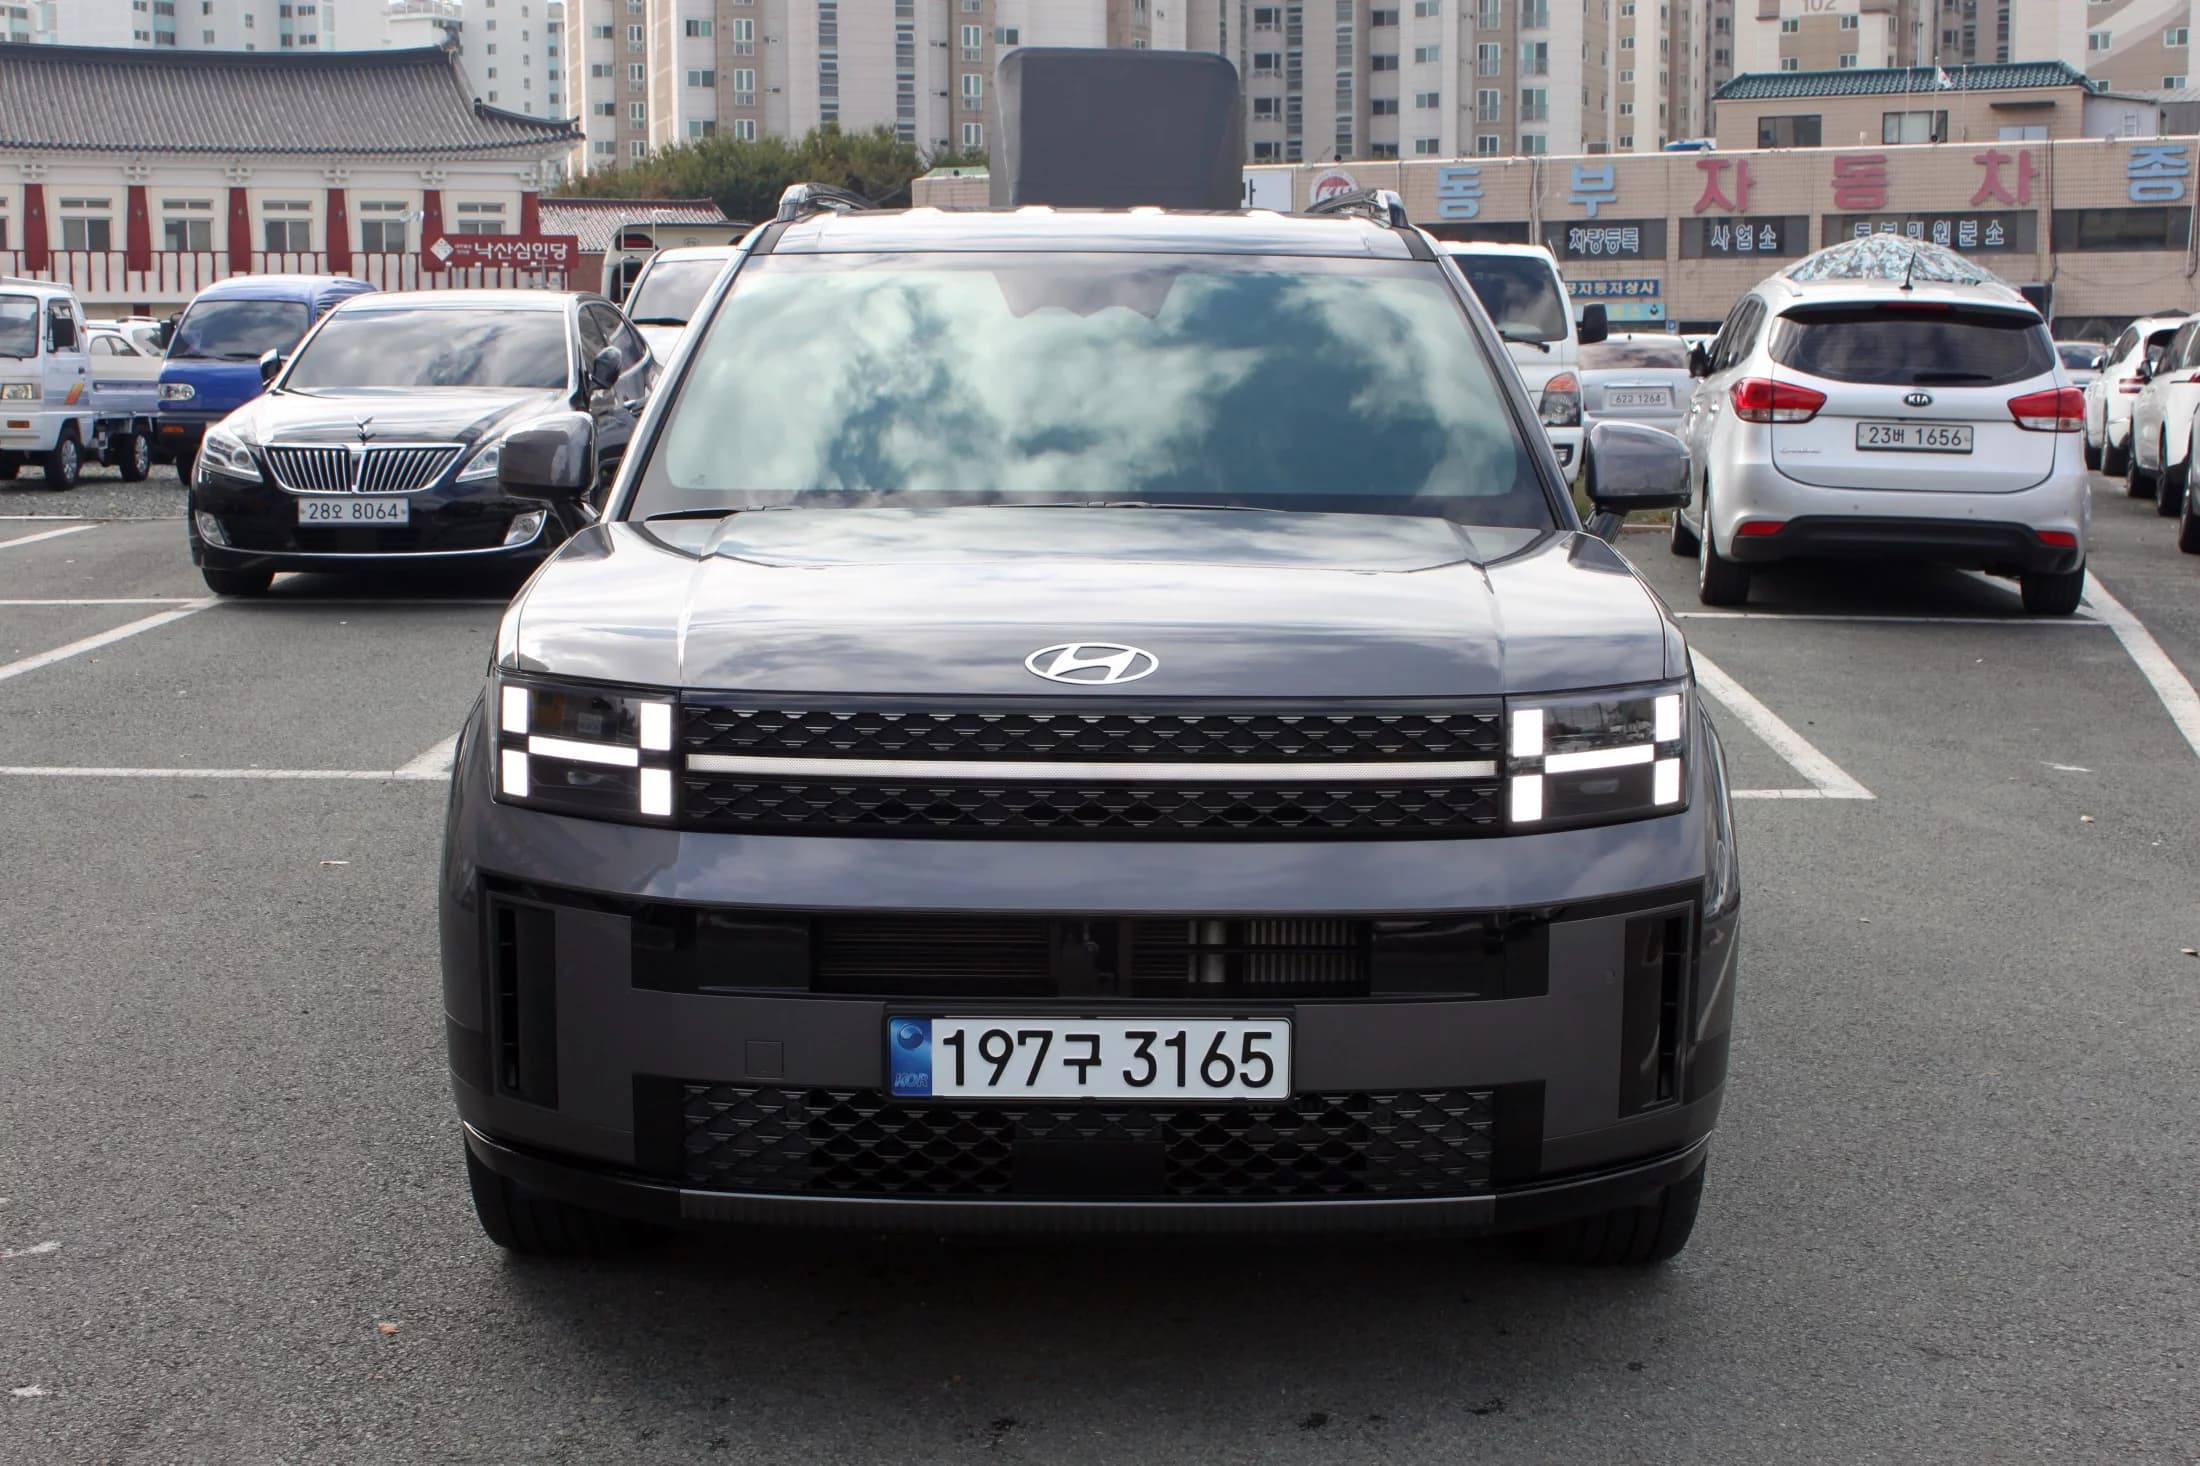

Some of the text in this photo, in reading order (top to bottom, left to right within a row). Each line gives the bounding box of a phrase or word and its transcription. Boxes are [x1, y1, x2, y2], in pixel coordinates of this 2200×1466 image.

[2127, 145, 2188, 202] 종
[1568, 227, 1639, 254] 차량등록
[1711, 224, 1777, 251] 사업소
[474, 242, 568, 260] 낙산심인당
[1908, 395, 1928, 404] KIA
[1868, 426, 1962, 447] 23버 1656
[308, 502, 399, 520] 28오 8064
[942, 1029, 1274, 1088] 197구 3165
[894, 1072, 929, 1088] KOR
